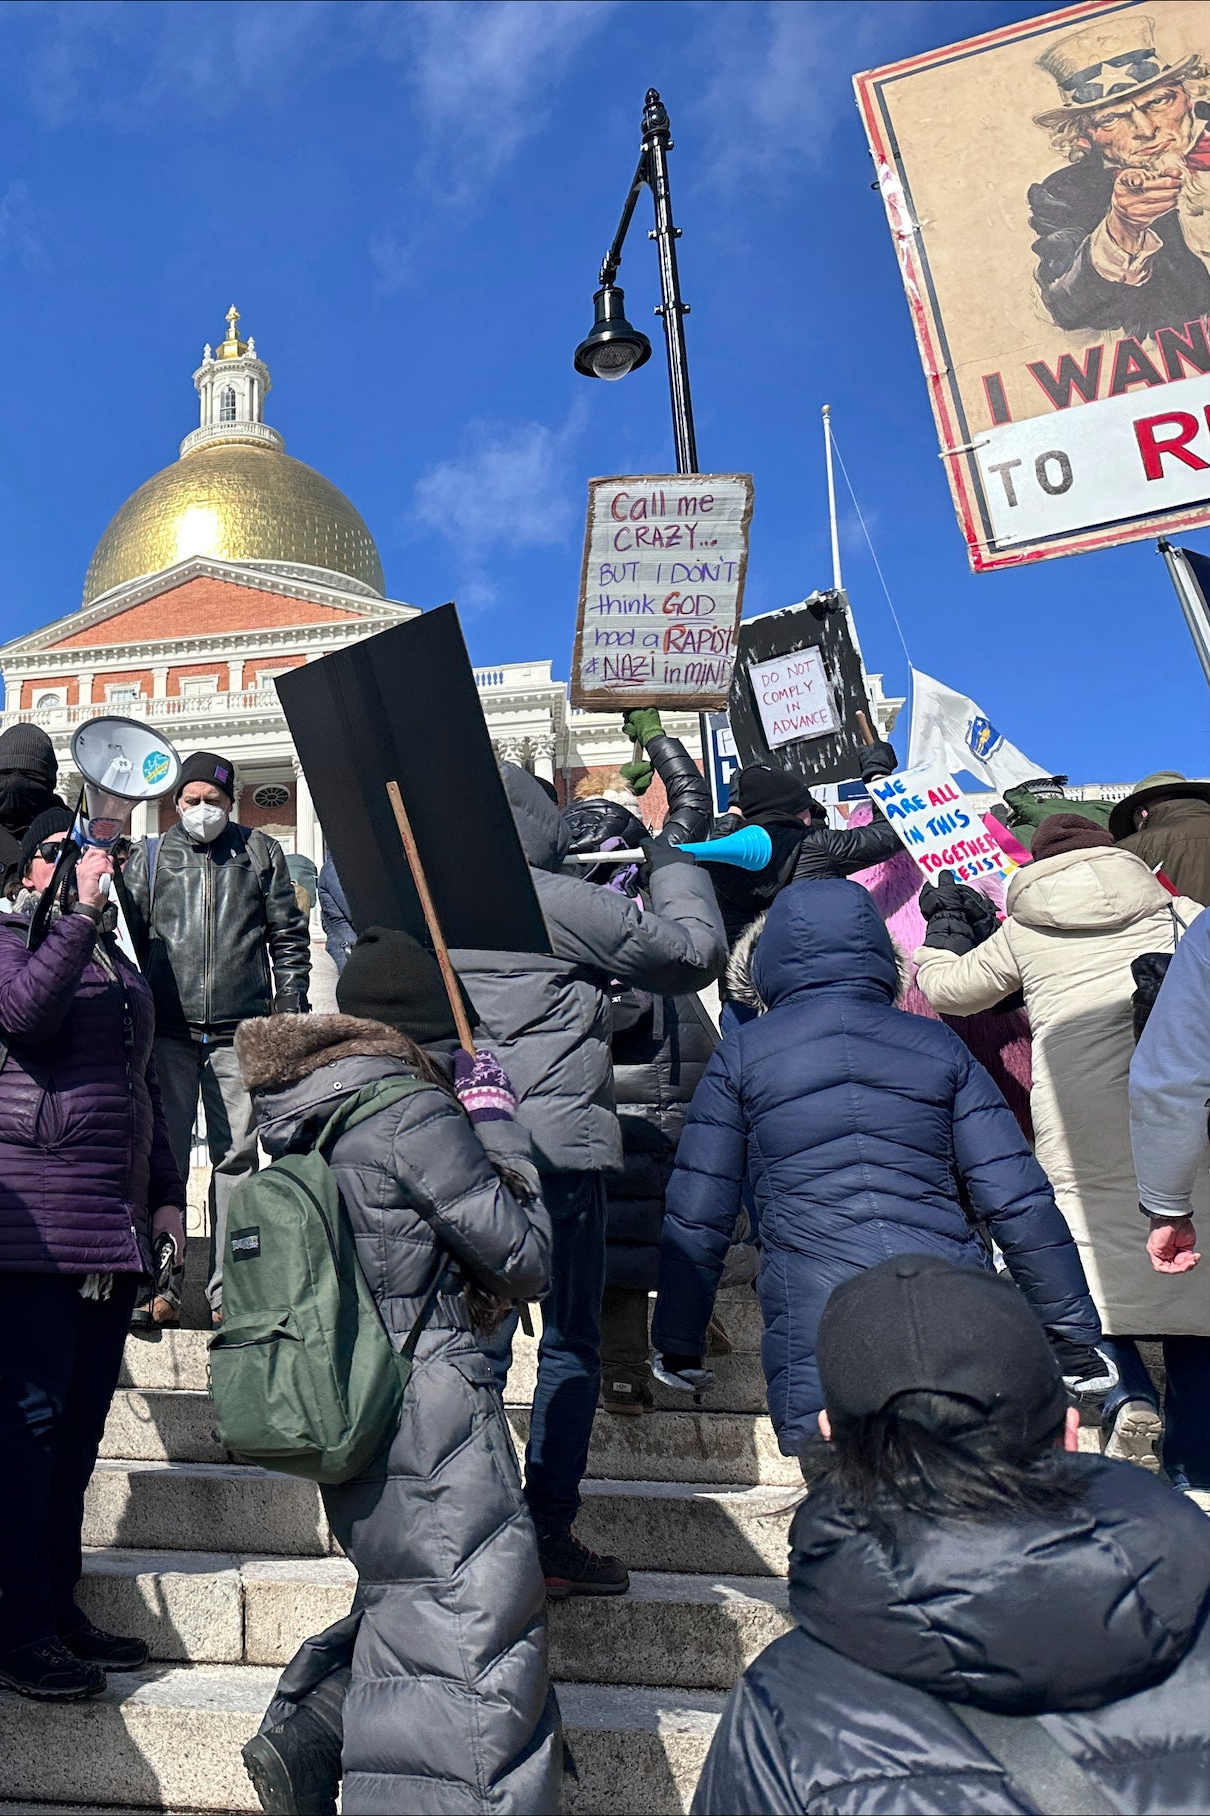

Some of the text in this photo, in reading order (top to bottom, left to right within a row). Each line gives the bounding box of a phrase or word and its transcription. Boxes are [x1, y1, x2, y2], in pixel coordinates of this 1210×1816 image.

[982, 320, 1210, 426] I WAN
[988, 404, 1210, 508] TO R
[611, 489, 714, 521] Call me
[598, 556, 737, 587] BUT I DON'T
[590, 591, 716, 616] think GOD
[595, 627, 635, 647] had
[643, 633, 658, 647] a
[664, 660, 680, 683] in
[761, 659, 815, 688] DO NOT
[762, 680, 814, 706] COMPLY
[786, 701, 801, 714] IN
[773, 708, 829, 736] ADVANCE
[873, 778, 907, 801] WE
[885, 783, 959, 820] ARE ALL
[903, 808, 971, 846] IN THIS
[918, 832, 998, 874] TOGETHER
